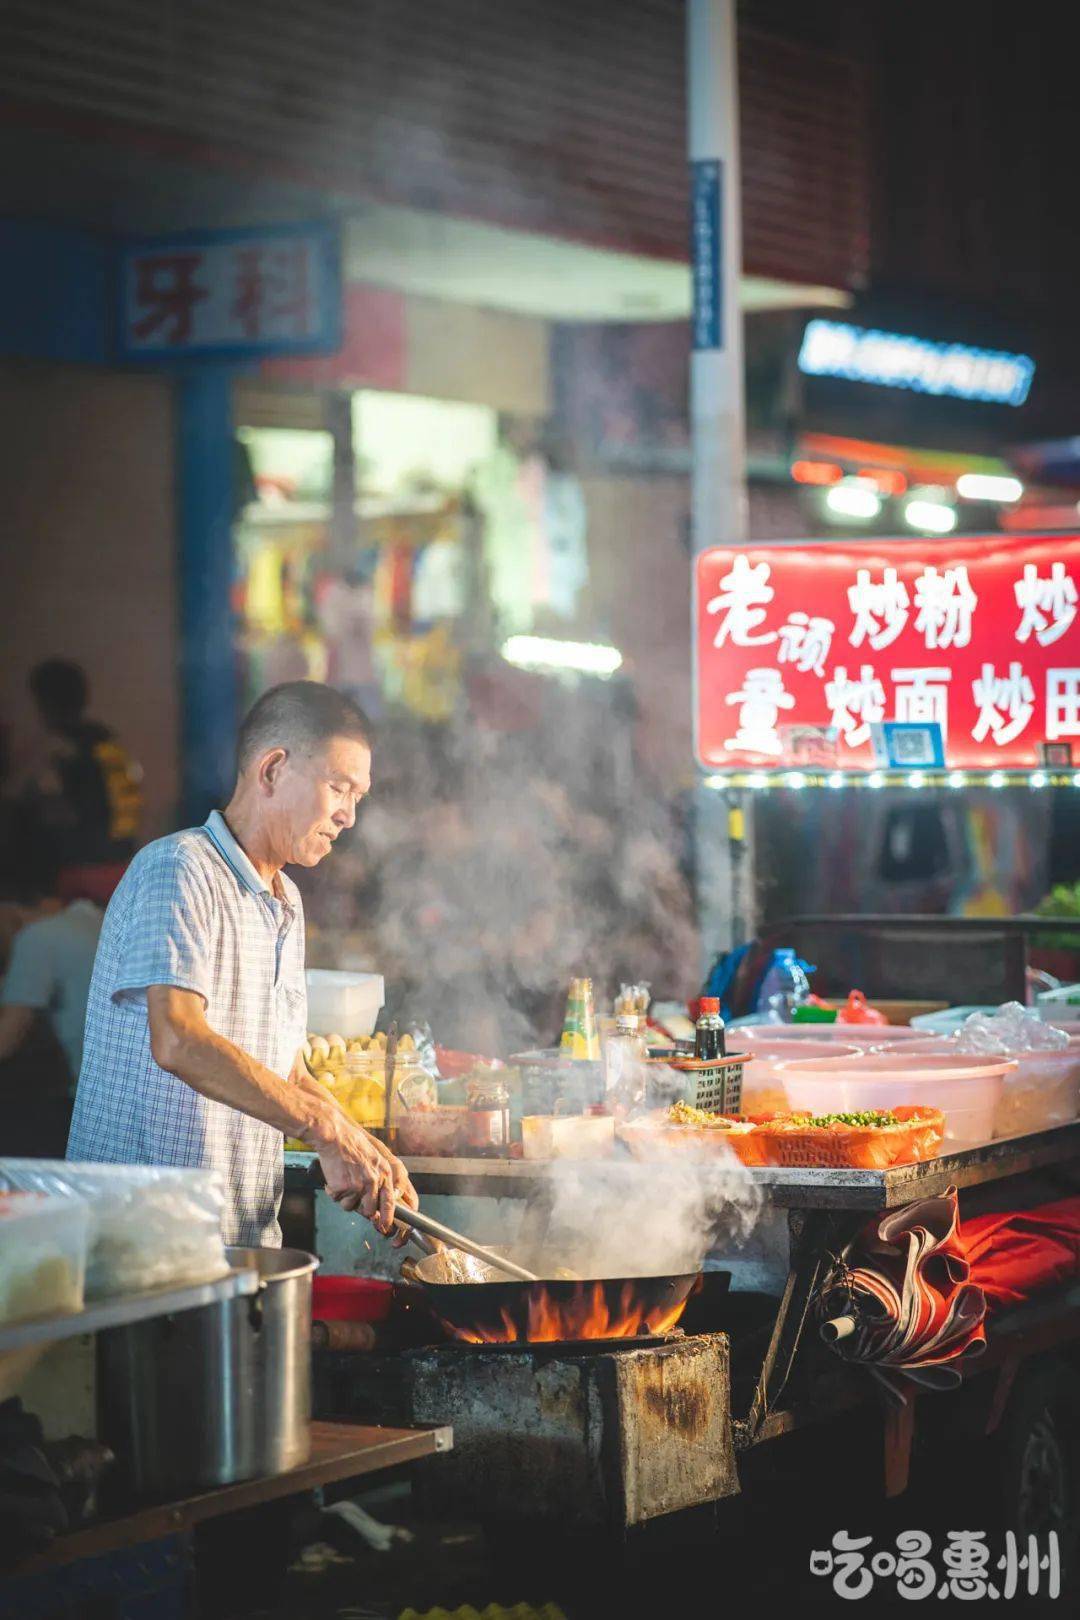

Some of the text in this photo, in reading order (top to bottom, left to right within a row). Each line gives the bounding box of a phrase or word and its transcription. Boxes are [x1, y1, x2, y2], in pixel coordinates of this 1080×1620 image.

[131, 244, 309, 345] 牙科
[847, 566, 978, 651] 炒粉
[1013, 562, 1078, 647] 炒
[824, 664, 952, 750] 炒面
